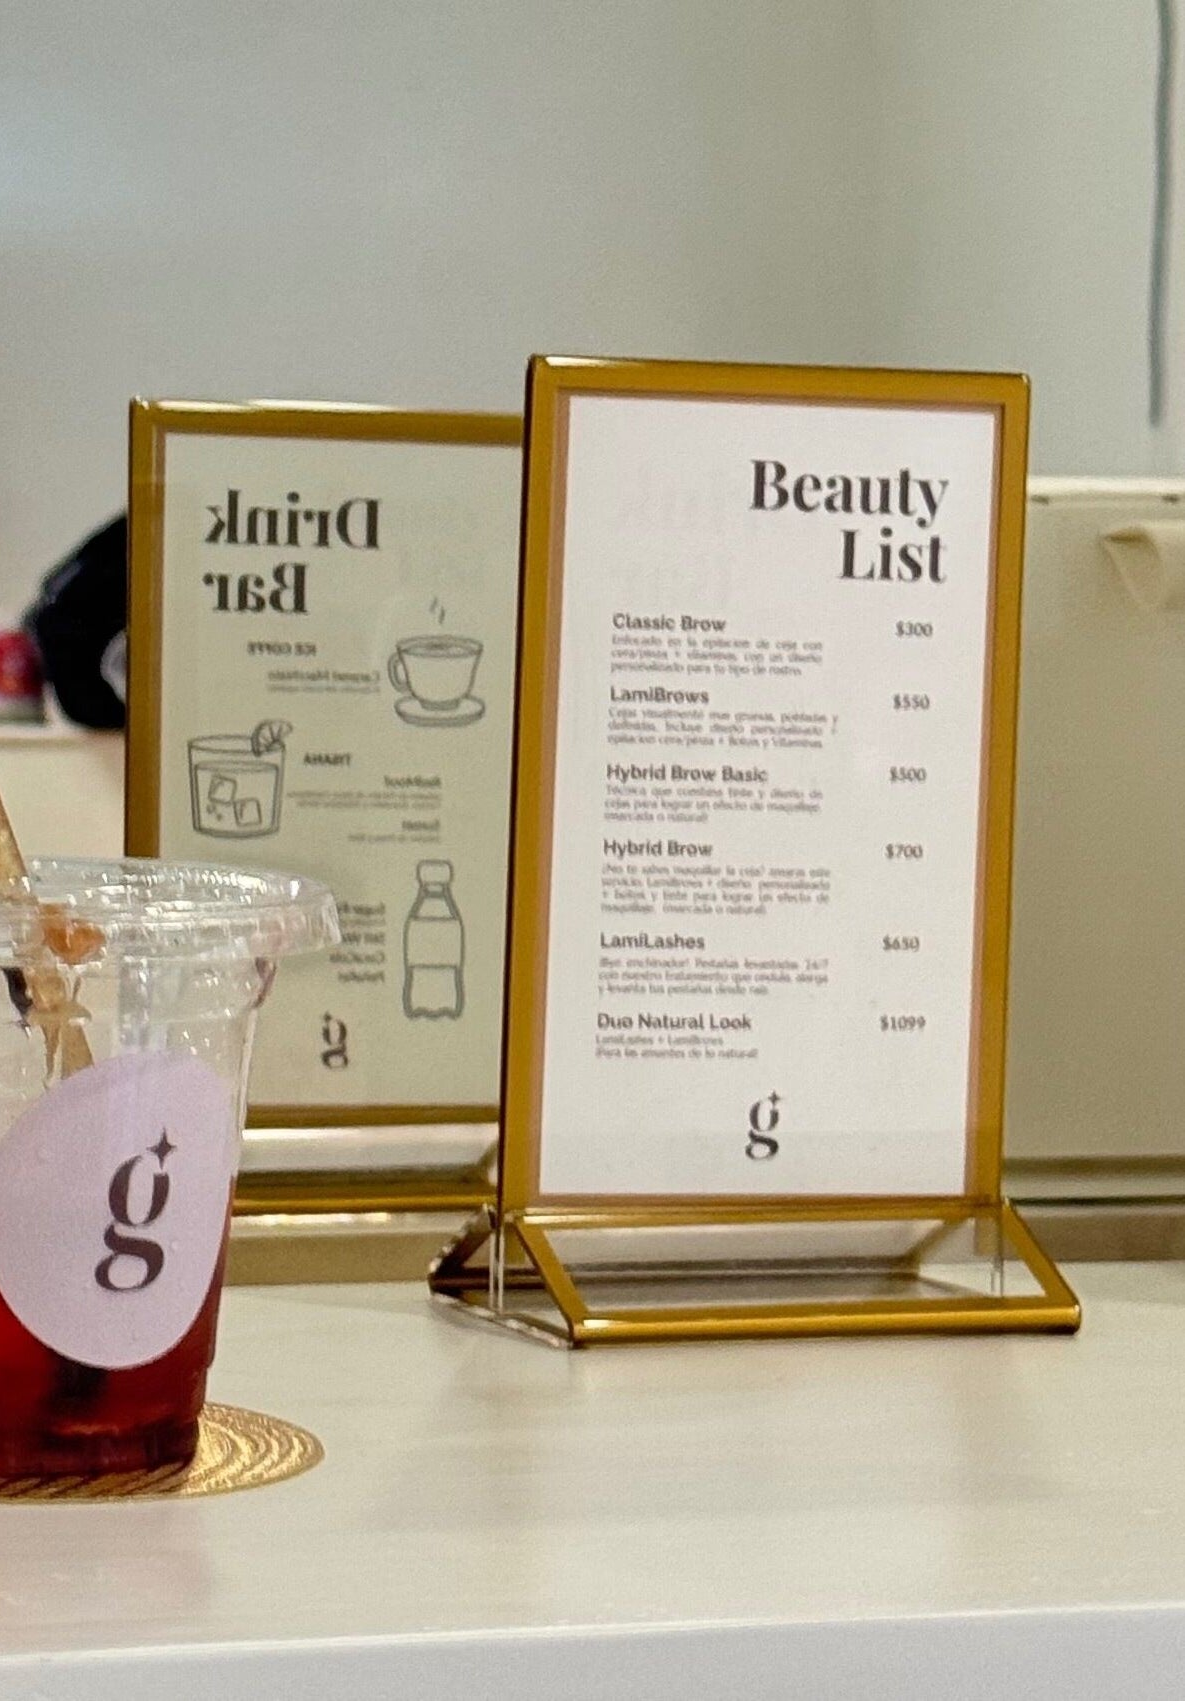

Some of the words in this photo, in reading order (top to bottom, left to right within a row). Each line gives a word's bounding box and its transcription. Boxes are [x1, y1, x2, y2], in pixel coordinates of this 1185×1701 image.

[749, 458, 949, 529] Beauty
[838, 526, 945, 584] List
[613, 613, 676, 631] Classic
[680, 615, 727, 632] Brow
[895, 620, 934, 638] $300
[611, 686, 710, 705] LamiBrows
[893, 693, 931, 711] $550
[607, 763, 667, 783] Hybrid
[671, 765, 717, 782] Brow
[722, 766, 769, 784] Basic
[889, 766, 927, 783] $500
[604, 838, 663, 858] Hybrid
[668, 840, 714, 858] Brow
[885, 843, 924, 860] $700
[600, 932, 706, 952] LamiLashes
[882, 935, 920, 953] $650
[597, 1012, 634, 1030] Duo
[638, 1012, 705, 1031] Natural
[710, 1014, 752, 1032] Look
[880, 1015, 927, 1032] $1099
[745, 1091, 781, 1161] g
[94, 1126, 177, 1292] g
